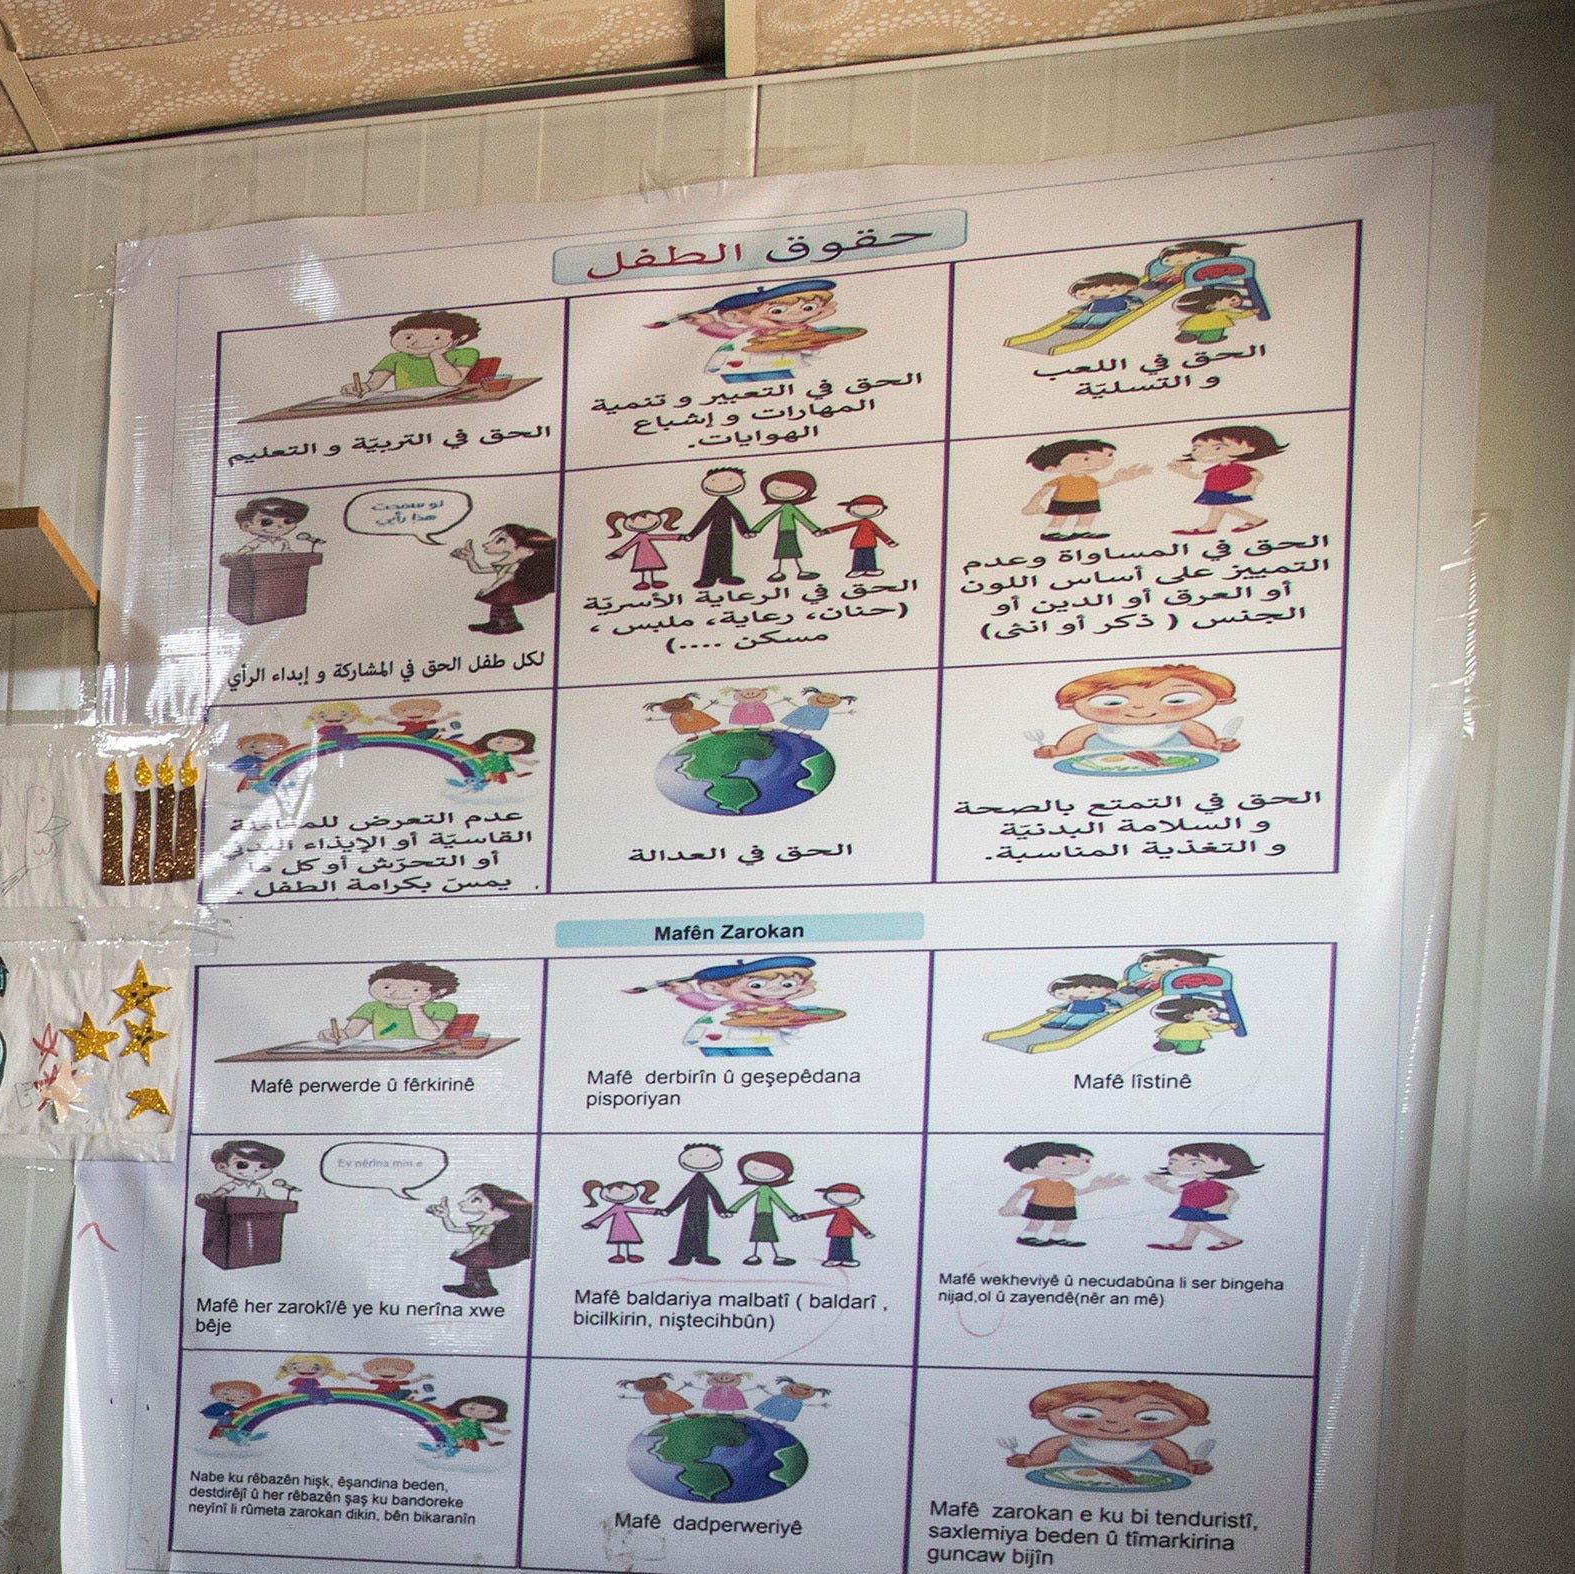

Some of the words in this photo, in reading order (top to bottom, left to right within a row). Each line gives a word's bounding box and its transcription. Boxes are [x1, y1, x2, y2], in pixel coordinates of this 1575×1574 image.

[765, 228, 933, 263] حقوق
[587, 242, 742, 280] الطفل
[1140, 354, 1169, 375] في
[1182, 344, 1266, 368] الحق
[1033, 358, 1127, 380] اللعب
[806, 379, 833, 400] في
[845, 372, 923, 394] الحق
[1200, 375, 1220, 389] و
[591, 394, 666, 414] تنمية
[679, 395, 692, 407] و
[702, 384, 793, 405] التعبير
[725, 413, 739, 426] و
[751, 399, 875, 421] المهارات
[633, 412, 713, 435] إشباع
[443, 429, 468, 448] في
[479, 426, 551, 444] الحق
[228, 442, 317, 466] التعليم
[328, 443, 341, 456] و
[1059, 543, 1188, 564] المساواة
[1202, 539, 1231, 561] في
[1245, 535, 1329, 556] الحق
[963, 554, 1046, 574] وعدم
[333, 662, 393, 681] المشاركة
[400, 659, 415, 682] في
[422, 656, 461, 678] الحق
[469, 653, 505, 674] طفل
[513, 651, 545, 672] لكل
[227, 664, 265, 692] الرأي
[272, 666, 309, 686] إبداء
[317, 671, 326, 683] و
[954, 800, 1075, 816] بالصحة
[1087, 796, 1181, 817] التمتع
[1195, 794, 1223, 814] في
[1238, 791, 1321, 810] الحق
[1118, 817, 1241, 833] السلامة
[1251, 819, 1270, 833] و
[629, 848, 725, 862] العدالة
[738, 845, 764, 866] في
[776, 843, 852, 862] الحق
[1141, 840, 1255, 860] التغذية
[1265, 842, 1286, 856] و
[655, 924, 714, 941] Mafên
[721, 924, 804, 940] Zarokan
[251, 1078, 293, 1093] Mafê
[299, 1078, 381, 1096] perwerde
[387, 1079, 397, 1092] û
[403, 1076, 475, 1092] fêrkirinê
[587, 1070, 633, 1085] Mafê
[645, 1069, 715, 1084] derbirîn
[724, 1070, 733, 1083] û
[741, 1069, 860, 1088] geşepêdana
[1074, 1074, 1123, 1089] Mafê
[1131, 1074, 1192, 1089] lîstinê
[586, 1092, 681, 1109] pisporiyan
[939, 1273, 976, 1285] Mafê
[981, 1274, 1059, 1288] wekheviyê
[1065, 1274, 1073, 1286] û
[1079, 1276, 1175, 1288] necudabûna
[1179, 1277, 1186, 1289] li
[1192, 1279, 1215, 1289] ser
[1221, 1278, 1284, 1293] bingeha
[575, 1289, 620, 1305] Mafê
[627, 1291, 711, 1309] baldariya
[719, 1292, 789, 1308] malbatî
[809, 1294, 877, 1310] baldarî
[996, 1290, 1004, 1302] û
[1110, 1294, 1129, 1304] an
[197, 1298, 239, 1312] Mafê
[245, 1299, 273, 1314] her
[353, 1303, 373, 1319] ye
[379, 1301, 400, 1316] ku
[407, 1302, 463, 1318] nerîna
[469, 1305, 505, 1318] xwe
[195, 1318, 231, 1335] bêje
[573, 1311, 653, 1328] bicilkirin,
[191, 1470, 224, 1482] Nabe
[229, 1472, 243, 1483] ku
[247, 1472, 299, 1486] rêbazên
[337, 1476, 399, 1490] êşandina
[930, 1500, 979, 1518] Mafê
[992, 1504, 1073, 1522] zarokan
[1080, 1508, 1092, 1522] e
[1100, 1507, 1123, 1524] ku
[1131, 1508, 1149, 1524] bi
[615, 1512, 661, 1529] Mafê
[673, 1516, 803, 1538] dadperweriyê
[929, 1524, 1028, 1544] saxlemiya
[1035, 1527, 1099, 1544] beden
[1106, 1530, 1118, 1546] û
[1126, 1531, 1235, 1551] tîmarkirina
[927, 1548, 1005, 1564] guncaw
[1013, 1549, 1053, 1568] bijîn
